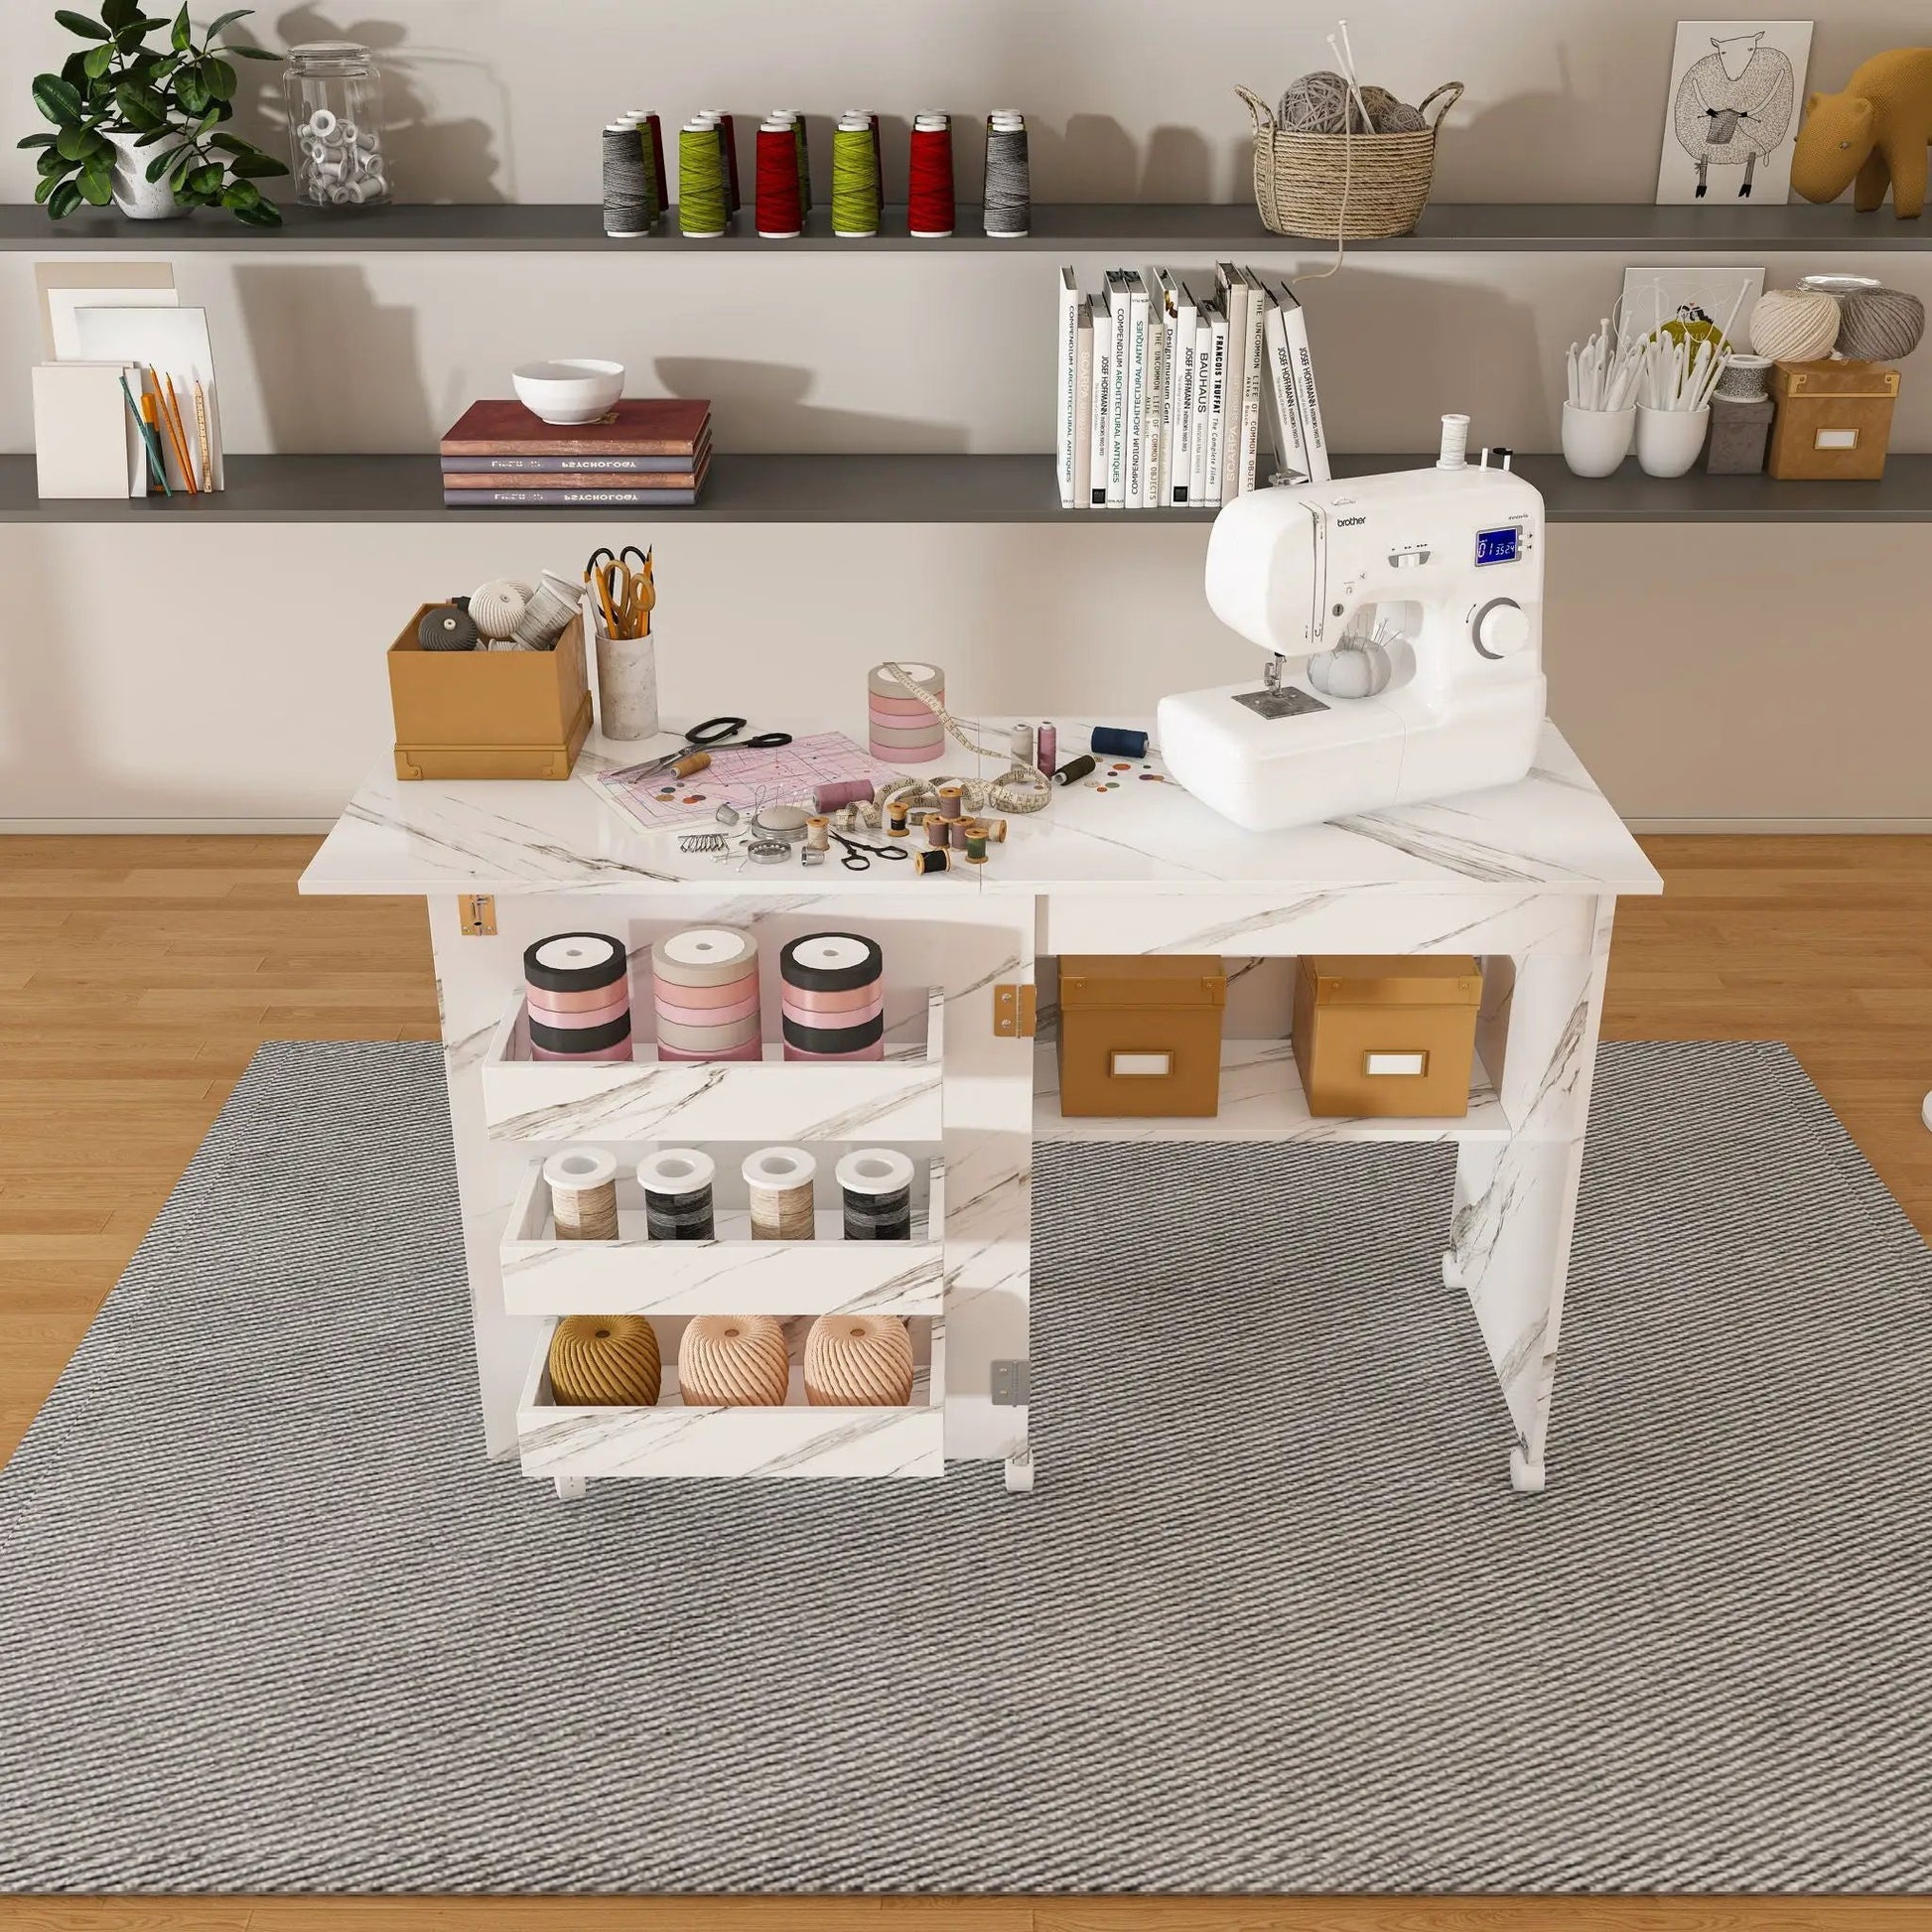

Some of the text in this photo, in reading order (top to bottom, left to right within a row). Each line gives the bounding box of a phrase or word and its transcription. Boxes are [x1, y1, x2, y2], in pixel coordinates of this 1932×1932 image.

[1164, 329, 1173, 359] Design
[1214, 336, 1224, 376] FRANCOIS
[1253, 322, 1262, 369] UNCOMMON
[1277, 346, 1289, 366] JOSEF
[1299, 346, 1311, 366] JOSEF
[1153, 350, 1162, 390] UNCOMMON
[1183, 368, 1193, 409] HOFFMANN
[1197, 352, 1208, 413] BAUHAUS
[1282, 366, 1296, 407] HOFFMANN
[1303, 366, 1316, 407] HOFFMANN
[1100, 376, 1109, 415] HOFFMANN
[1112, 308, 1125, 483] COMPENDIUM ARCHITECTURAL ANTIQUES
[1131, 320, 1145, 495] COMPENDIUM ARCHITECTURAL ANTIQUES
[1152, 395, 1161, 414] LIFE
[1212, 379, 1222, 414] TRUFFAT
[1251, 403, 1258, 413] OF
[1152, 419, 1160, 428] OF
[1226, 426, 1238, 483] SCARPA
[1149, 467, 1158, 500] OBJECTS
[1336, 516, 1366, 527] brother
